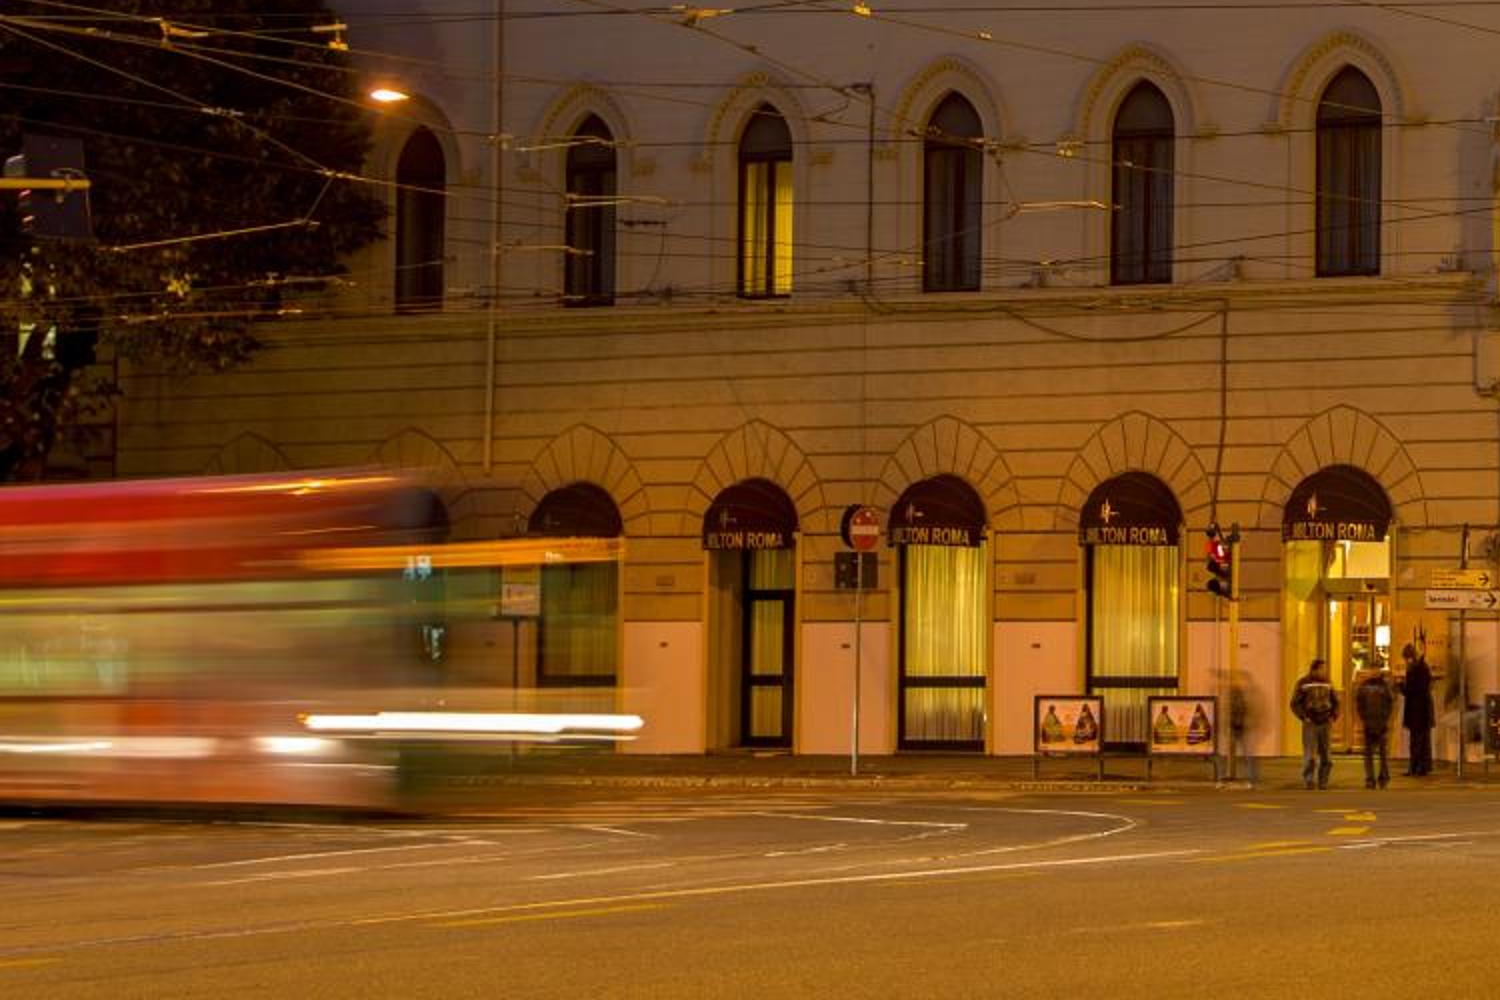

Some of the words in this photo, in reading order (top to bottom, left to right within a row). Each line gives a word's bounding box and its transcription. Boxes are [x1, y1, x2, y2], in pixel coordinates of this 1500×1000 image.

[747, 531, 783, 549] ROMA
[931, 528, 970, 546] ROMA
[1130, 527, 1169, 546] ROMA
[1338, 523, 1375, 540] ROMA
